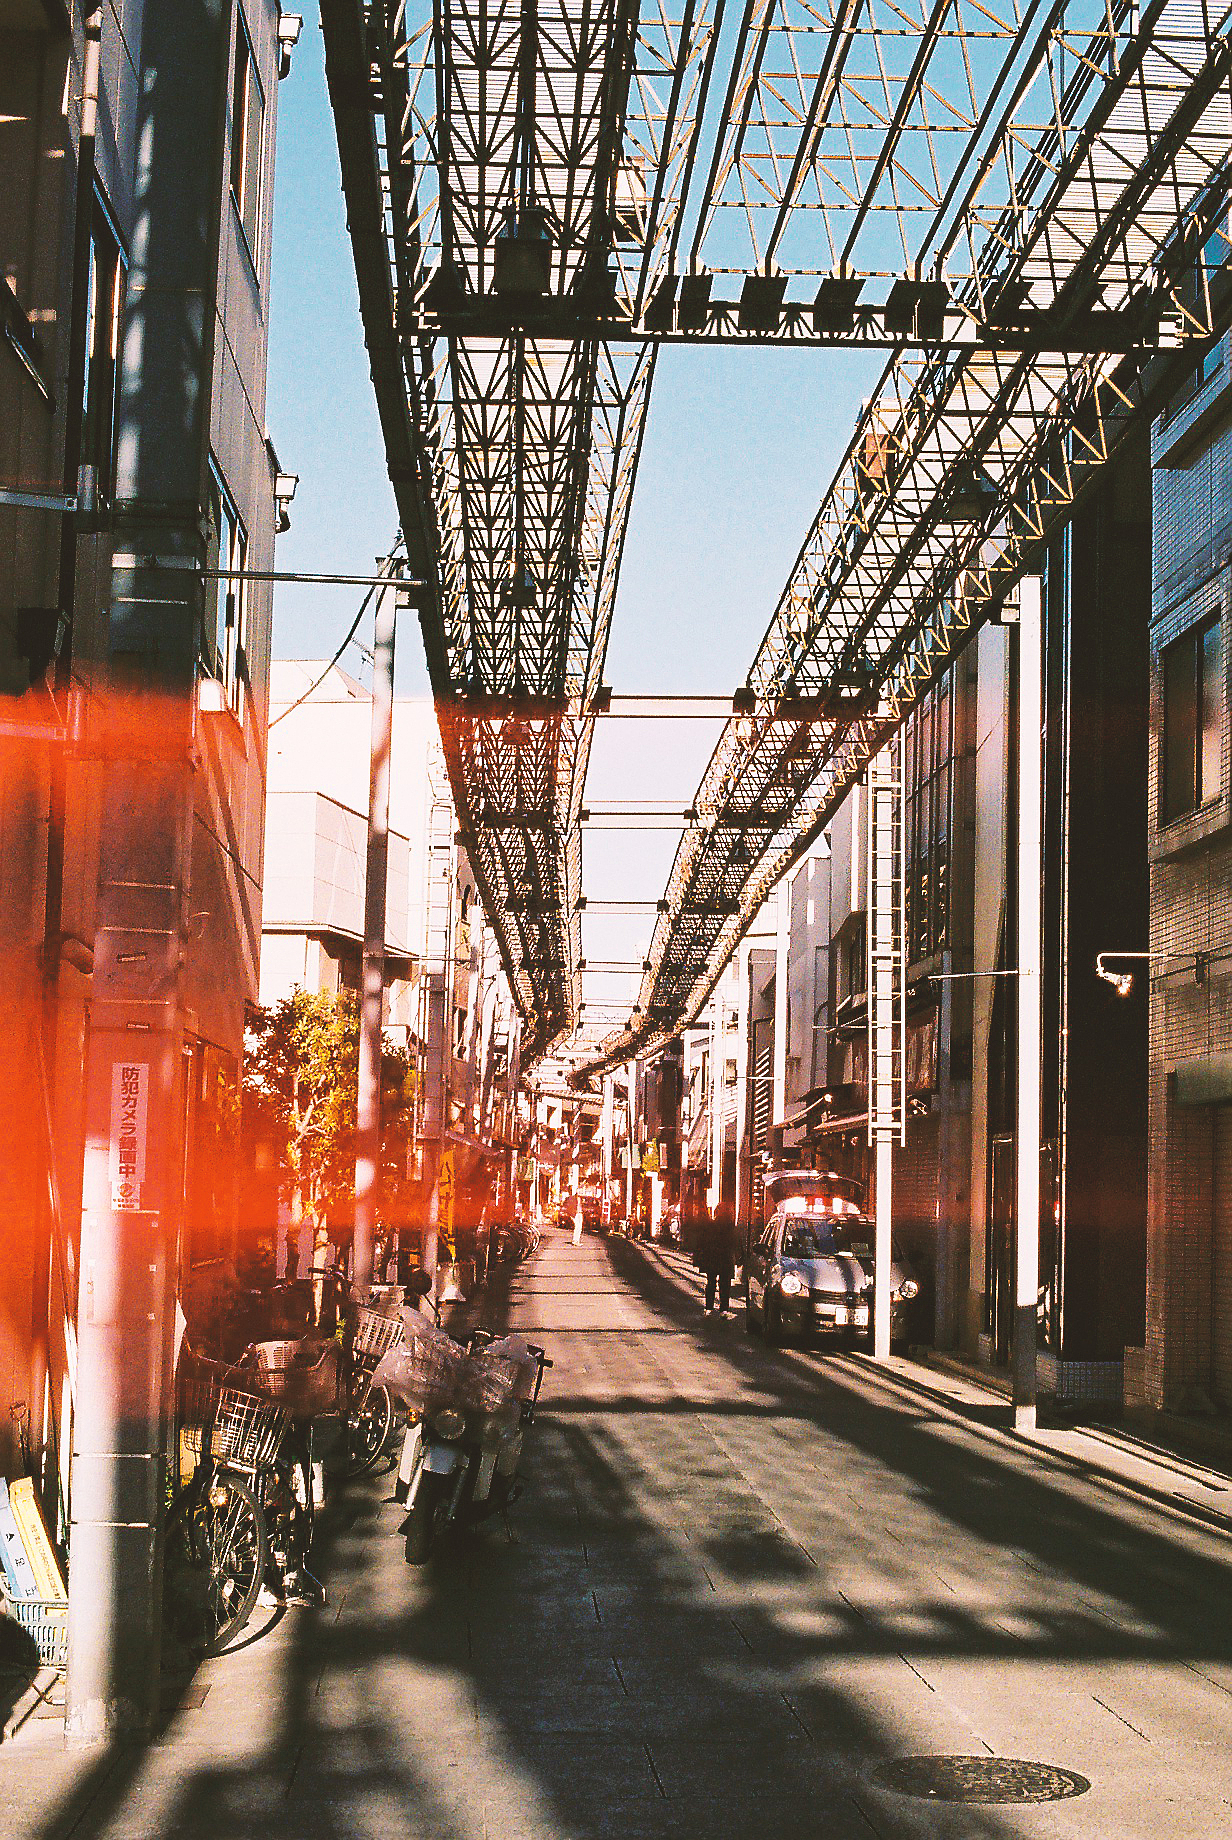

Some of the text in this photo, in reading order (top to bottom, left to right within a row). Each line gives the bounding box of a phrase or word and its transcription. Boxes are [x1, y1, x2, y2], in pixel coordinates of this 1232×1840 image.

[119, 1067, 141, 1178] 防犯カメラ録画中
